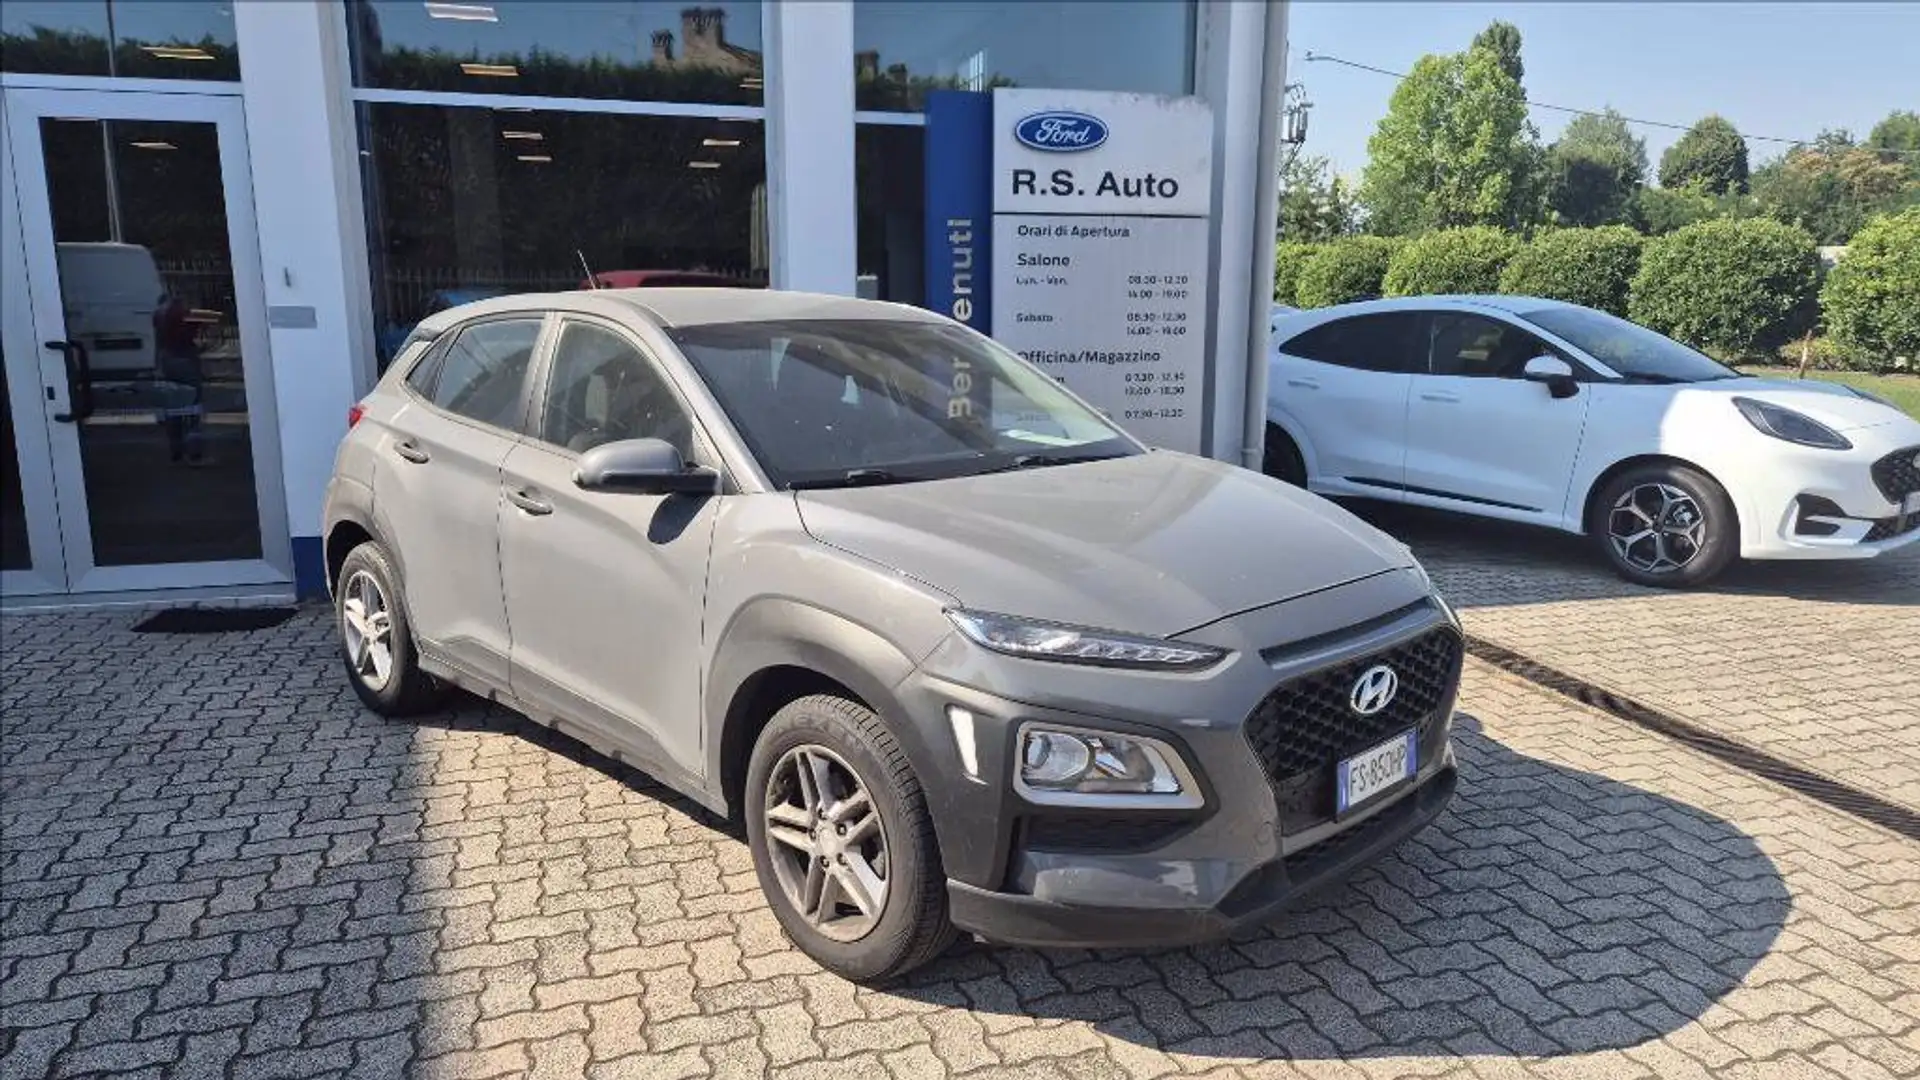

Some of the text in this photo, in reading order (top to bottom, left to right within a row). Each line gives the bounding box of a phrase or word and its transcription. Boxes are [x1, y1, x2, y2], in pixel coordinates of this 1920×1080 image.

[1035, 118, 1090, 144] Ford
[1012, 169, 1179, 198] R.S. Auto
[1017, 225, 1130, 239] Orari di Apertura
[1017, 253, 1070, 267] Salone
